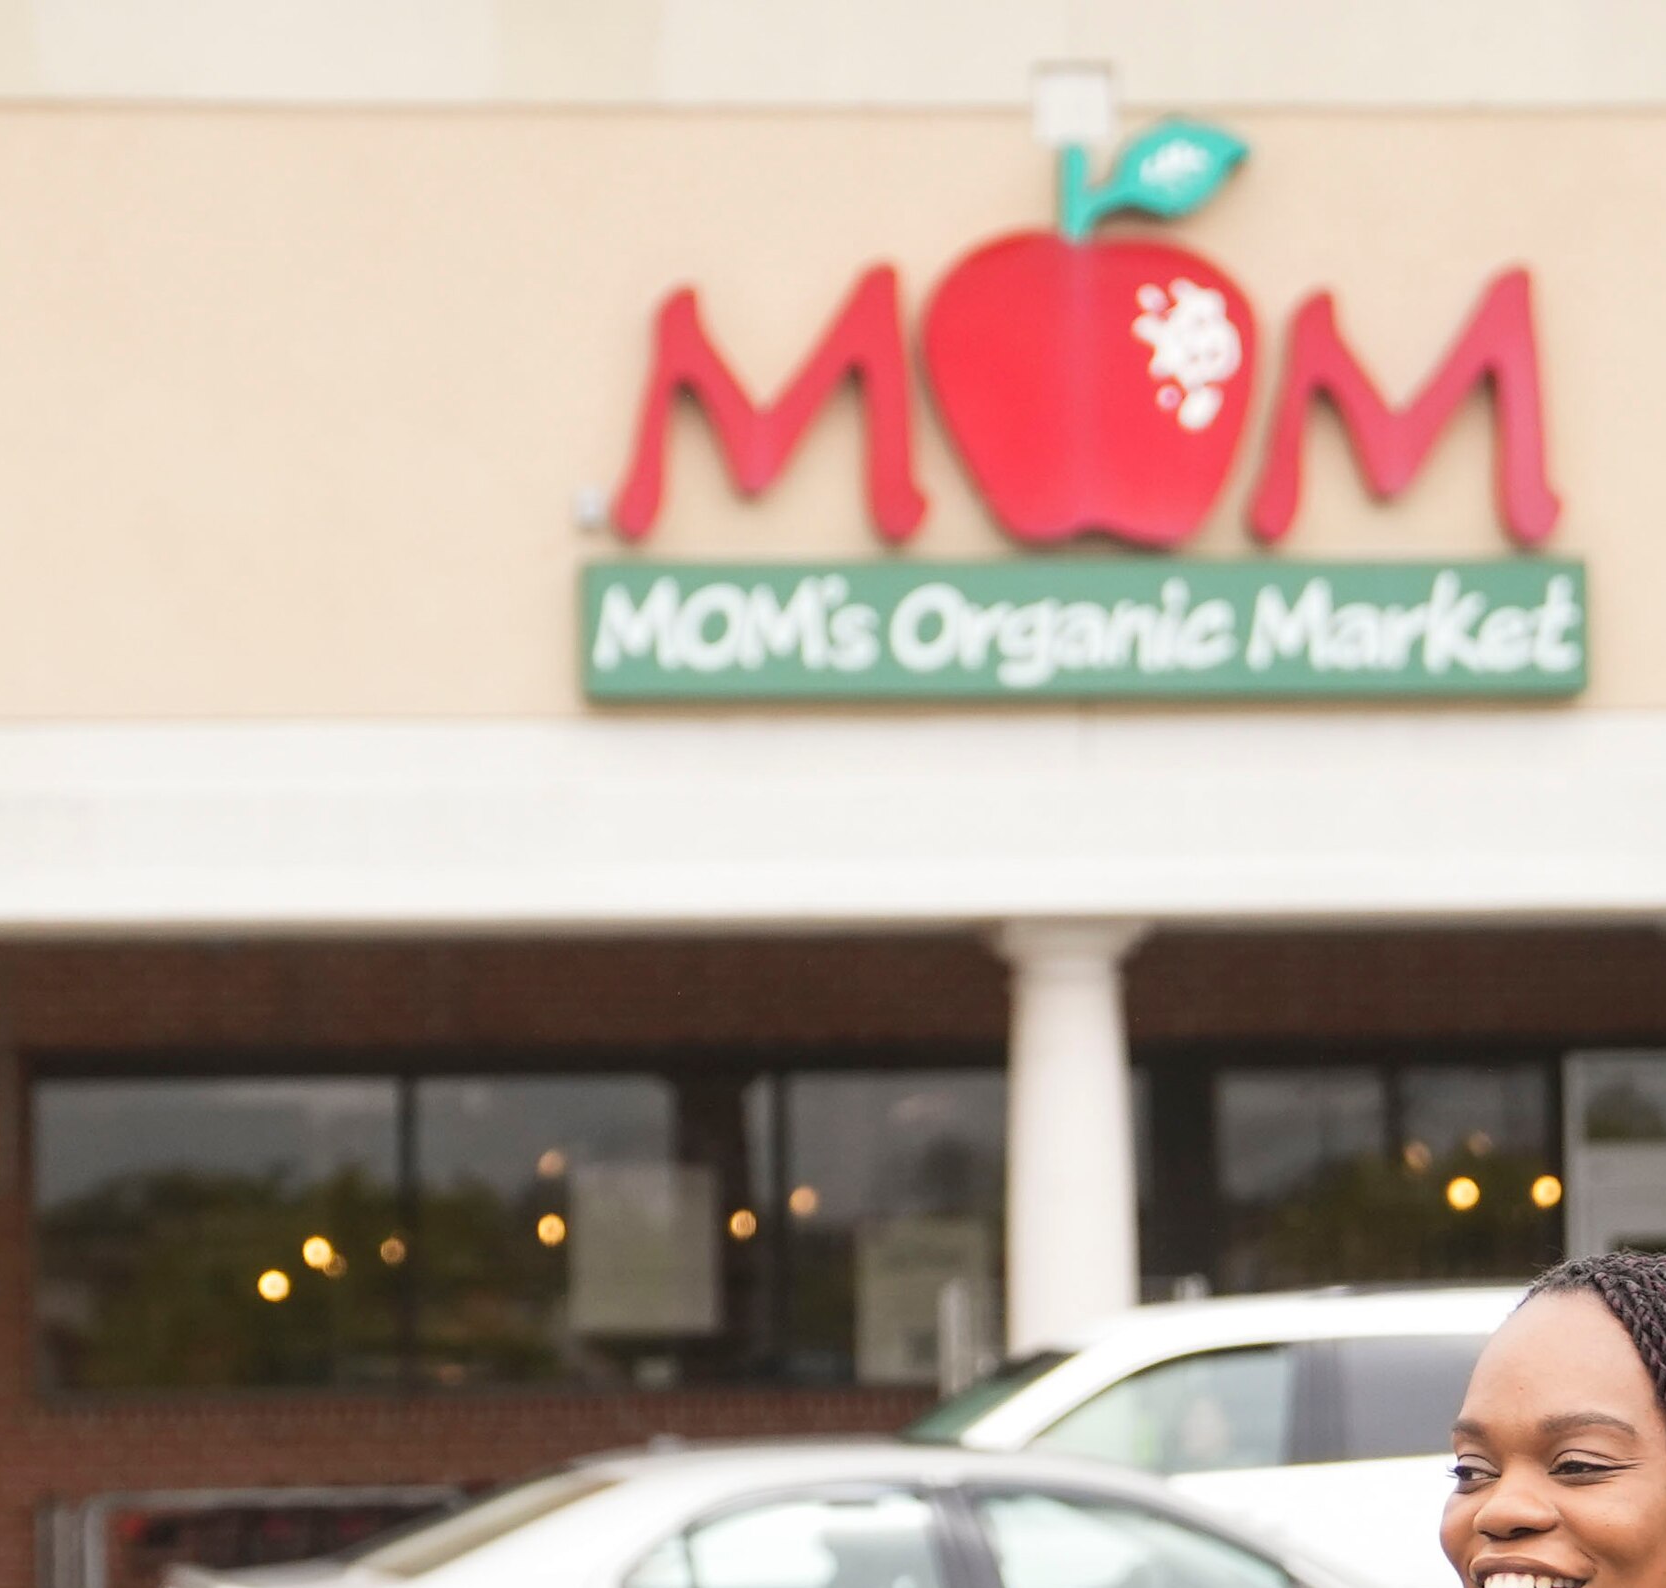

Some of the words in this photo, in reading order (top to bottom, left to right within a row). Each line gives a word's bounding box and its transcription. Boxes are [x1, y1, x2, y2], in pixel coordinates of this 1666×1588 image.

[593, 573, 880, 672] MOM's
[889, 582, 1236, 688] Organic
[1246, 569, 1582, 674] Market
